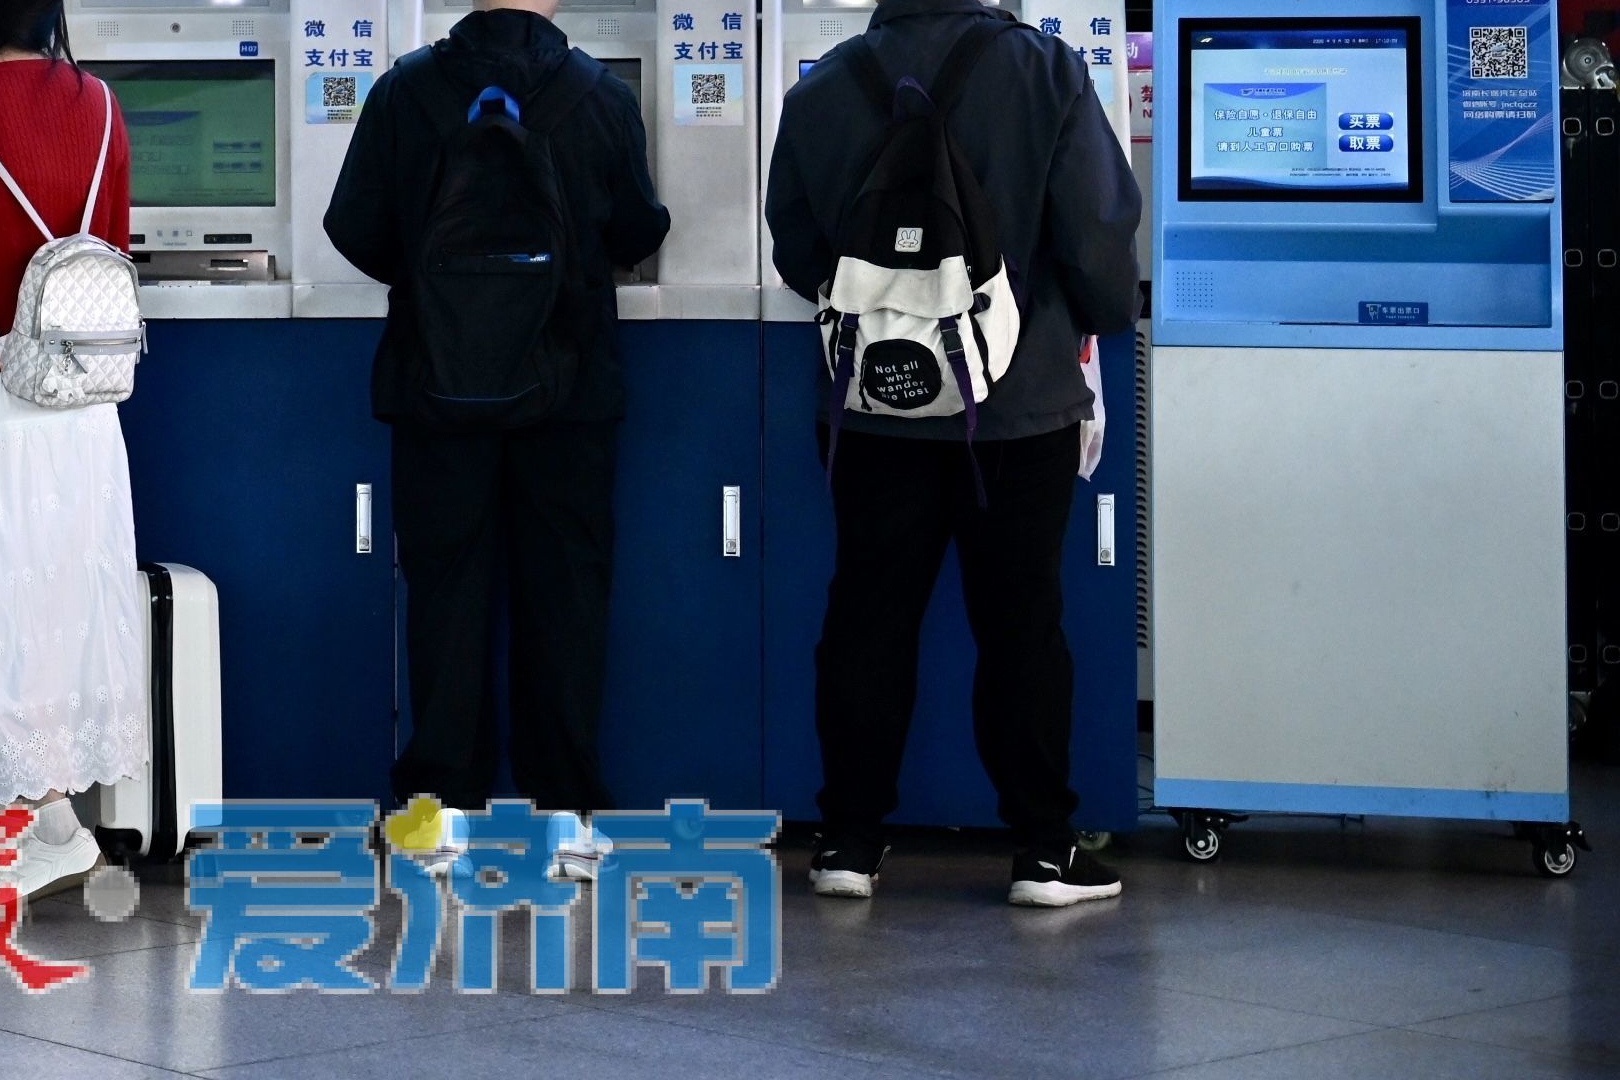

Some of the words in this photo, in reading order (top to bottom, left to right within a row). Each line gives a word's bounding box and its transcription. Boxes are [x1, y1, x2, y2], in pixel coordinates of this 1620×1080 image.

[304, 19, 374, 38] 微信
[672, 12, 743, 31] 微信
[1039, 17, 1112, 35] 微信
[304, 48, 374, 68] 支付宝
[673, 41, 744, 61] 支付宝
[1348, 114, 1381, 129] 买票
[1247, 126, 1284, 138] 儿童票
[1217, 141, 1315, 152] 请到人工窗口购票
[1348, 136, 1381, 151] 取票
[874, 364, 898, 374] Not
[902, 360, 919, 371] all
[885, 373, 912, 383] who
[876, 380, 925, 393] wander
[903, 387, 930, 399] lost
